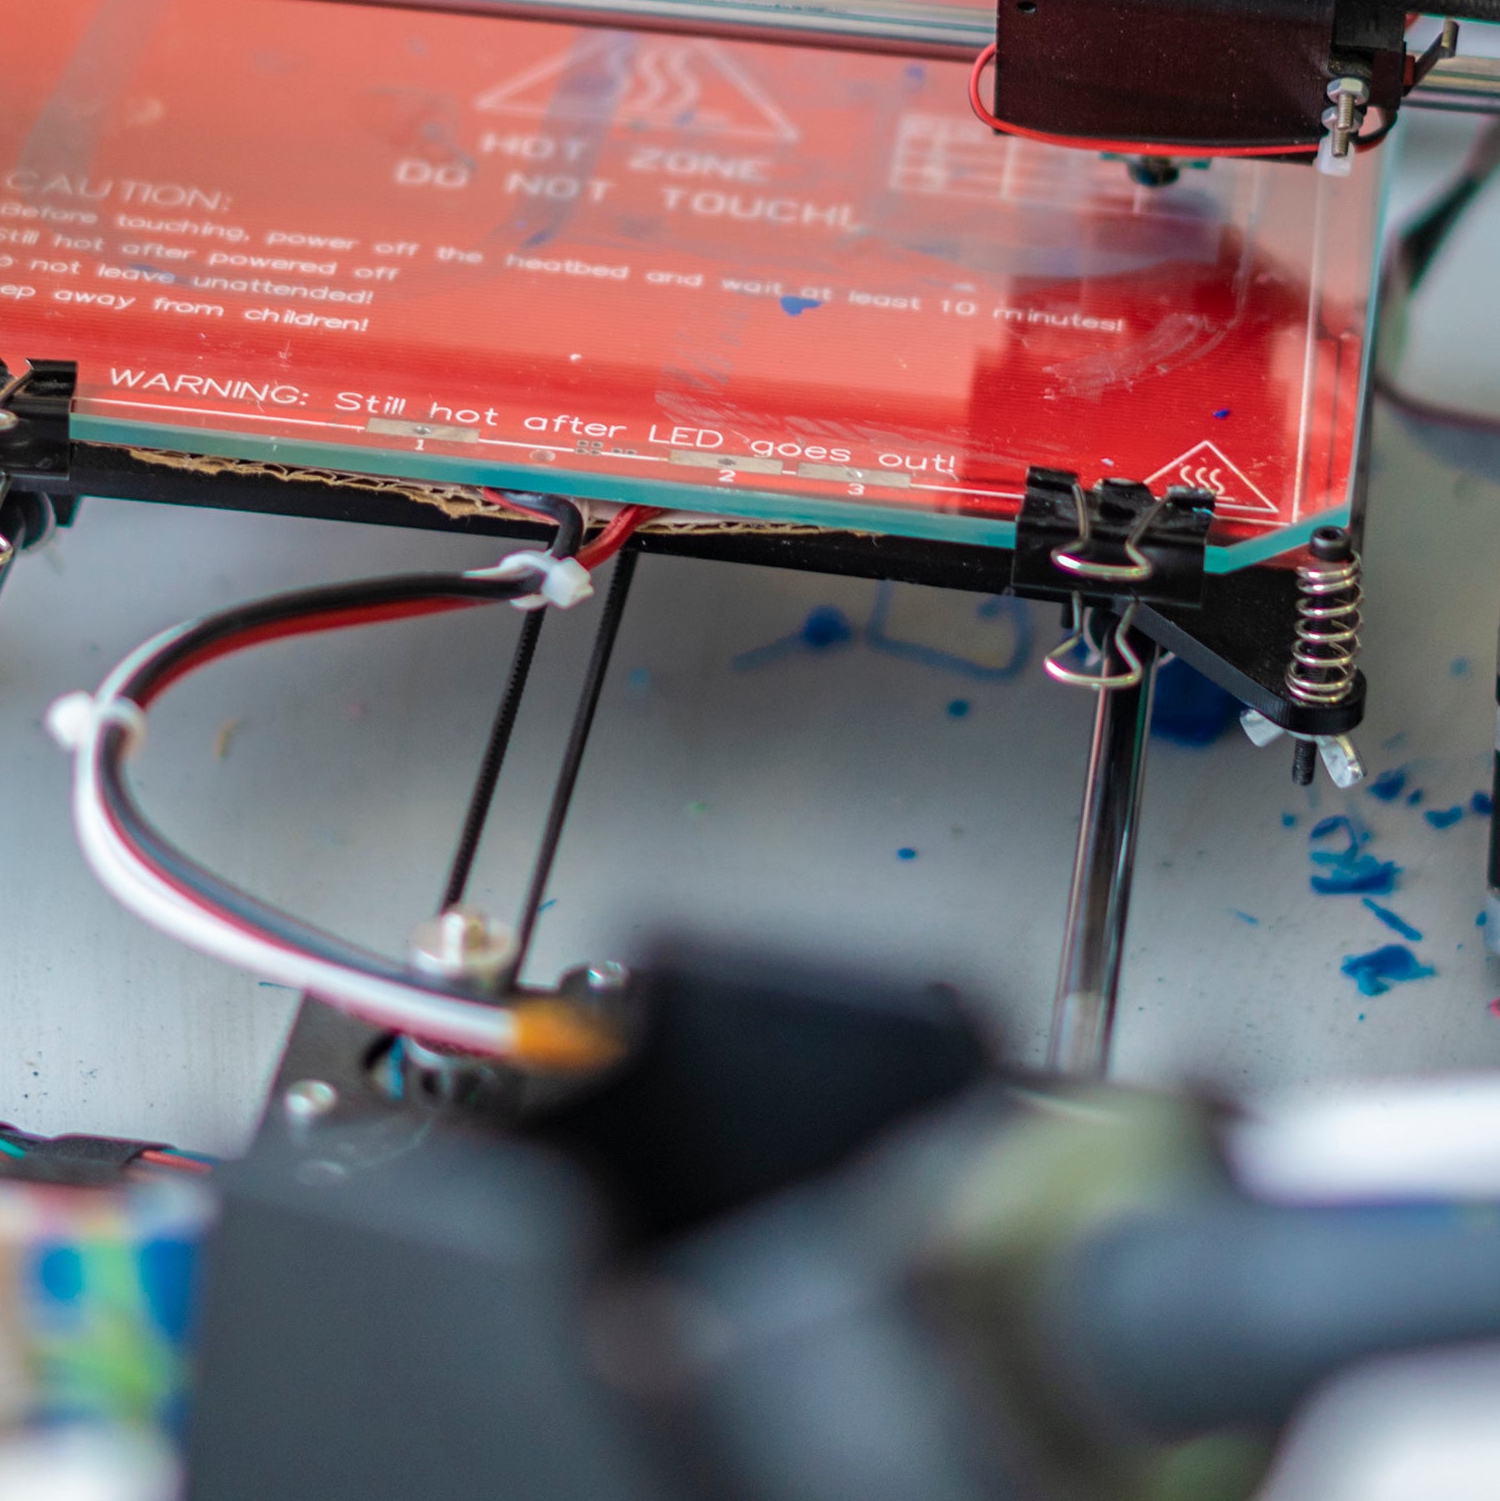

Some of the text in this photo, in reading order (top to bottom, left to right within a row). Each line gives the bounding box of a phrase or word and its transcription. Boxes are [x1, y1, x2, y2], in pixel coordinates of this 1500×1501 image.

[393, 159, 470, 189] DO
[504, 172, 617, 203] NOT
[479, 132, 773, 184] HOT ZONE
[5, 169, 233, 212] CAUTION:
[0, 200, 1123, 333] Before touching, power off the heatbed and wait at least 10 minutes!
[53, 233, 106, 251] hot
[121, 242, 198, 260] after
[208, 251, 338, 276] powered
[354, 263, 402, 282] off
[30, 258, 82, 275] not
[97, 263, 176, 285] leave
[193, 273, 374, 306] unattended!
[54, 289, 137, 311] away
[153, 297, 225, 317] from
[244, 306, 370, 334] children!
[109, 366, 956, 476] WARNING: Still hot after LED goes out!
[717, 469, 736, 483] 2
[847, 483, 865, 497] 3
